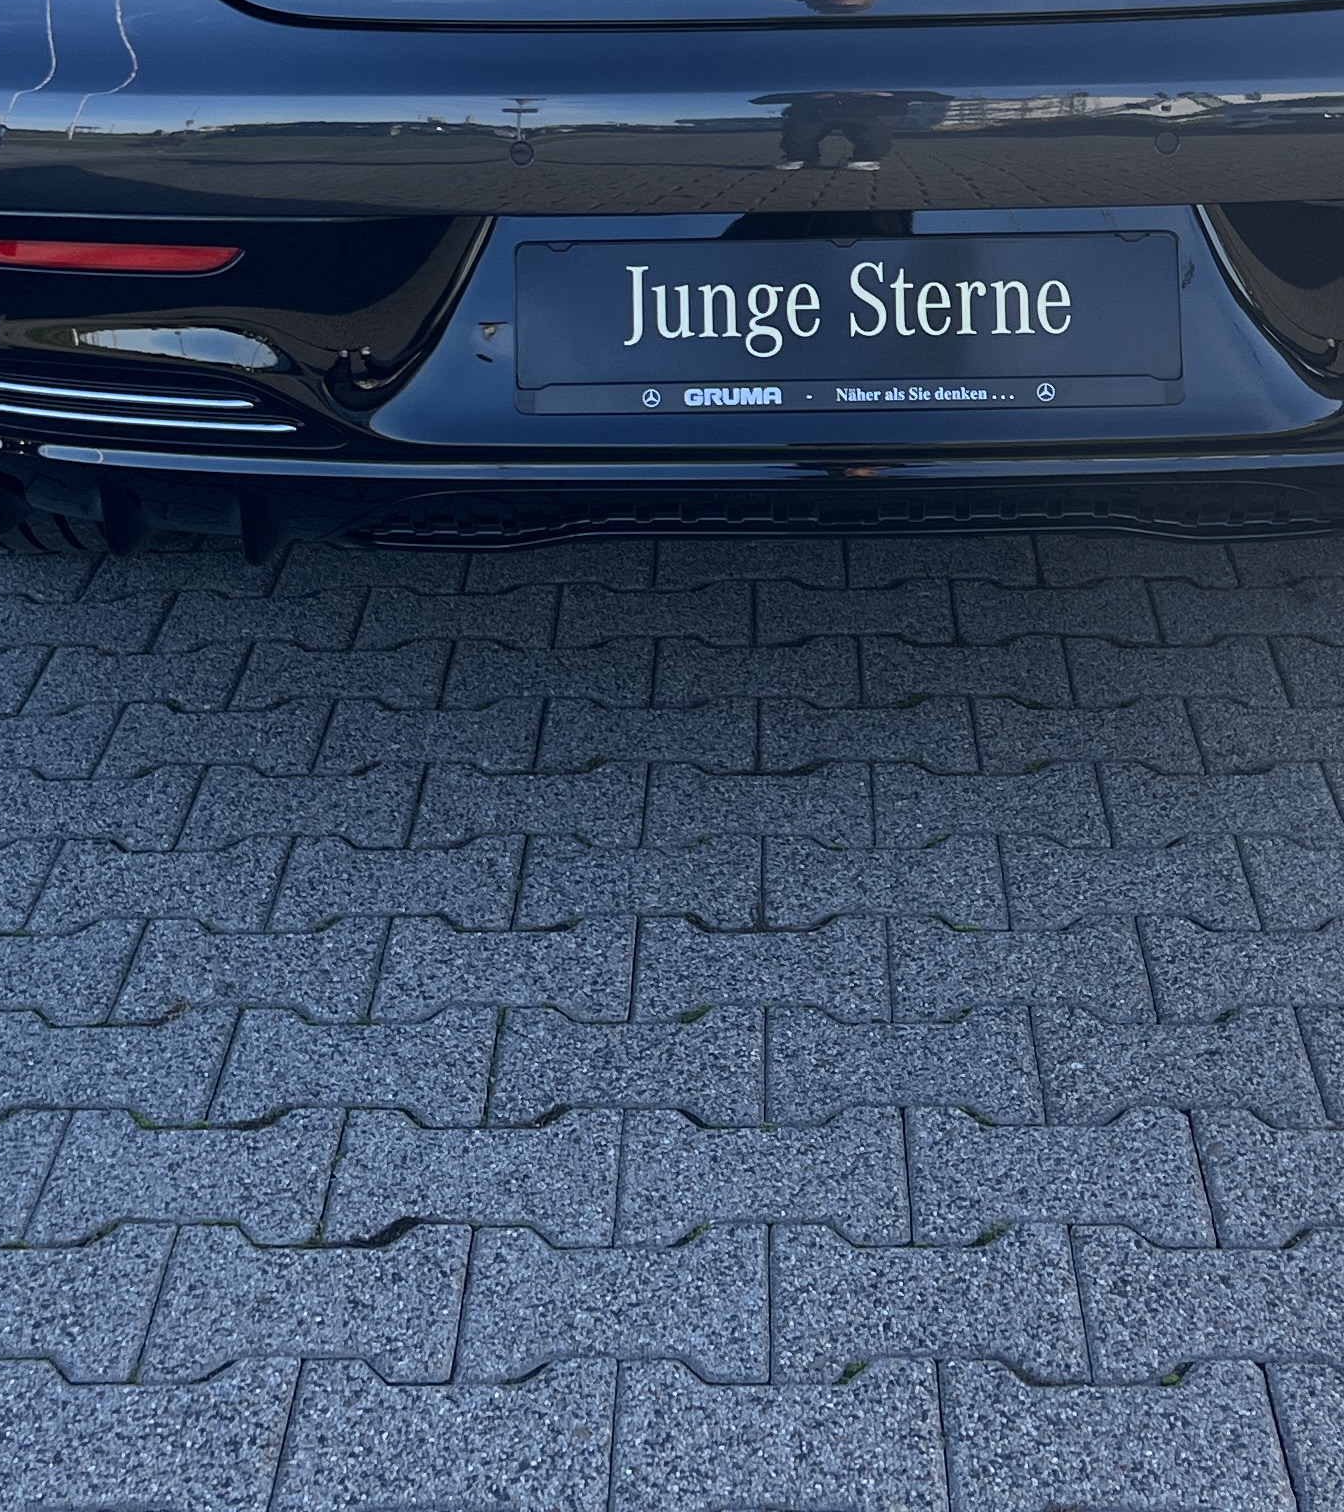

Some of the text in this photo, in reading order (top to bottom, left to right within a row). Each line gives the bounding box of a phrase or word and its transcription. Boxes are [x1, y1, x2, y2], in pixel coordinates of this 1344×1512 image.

[624, 262, 1073, 358] Junge Sterne
[684, 387, 782, 406] GRUMA
[836, 387, 881, 402] Näher
[884, 387, 905, 401] als
[908, 387, 931, 401] Sie
[934, 386, 988, 400] denken
